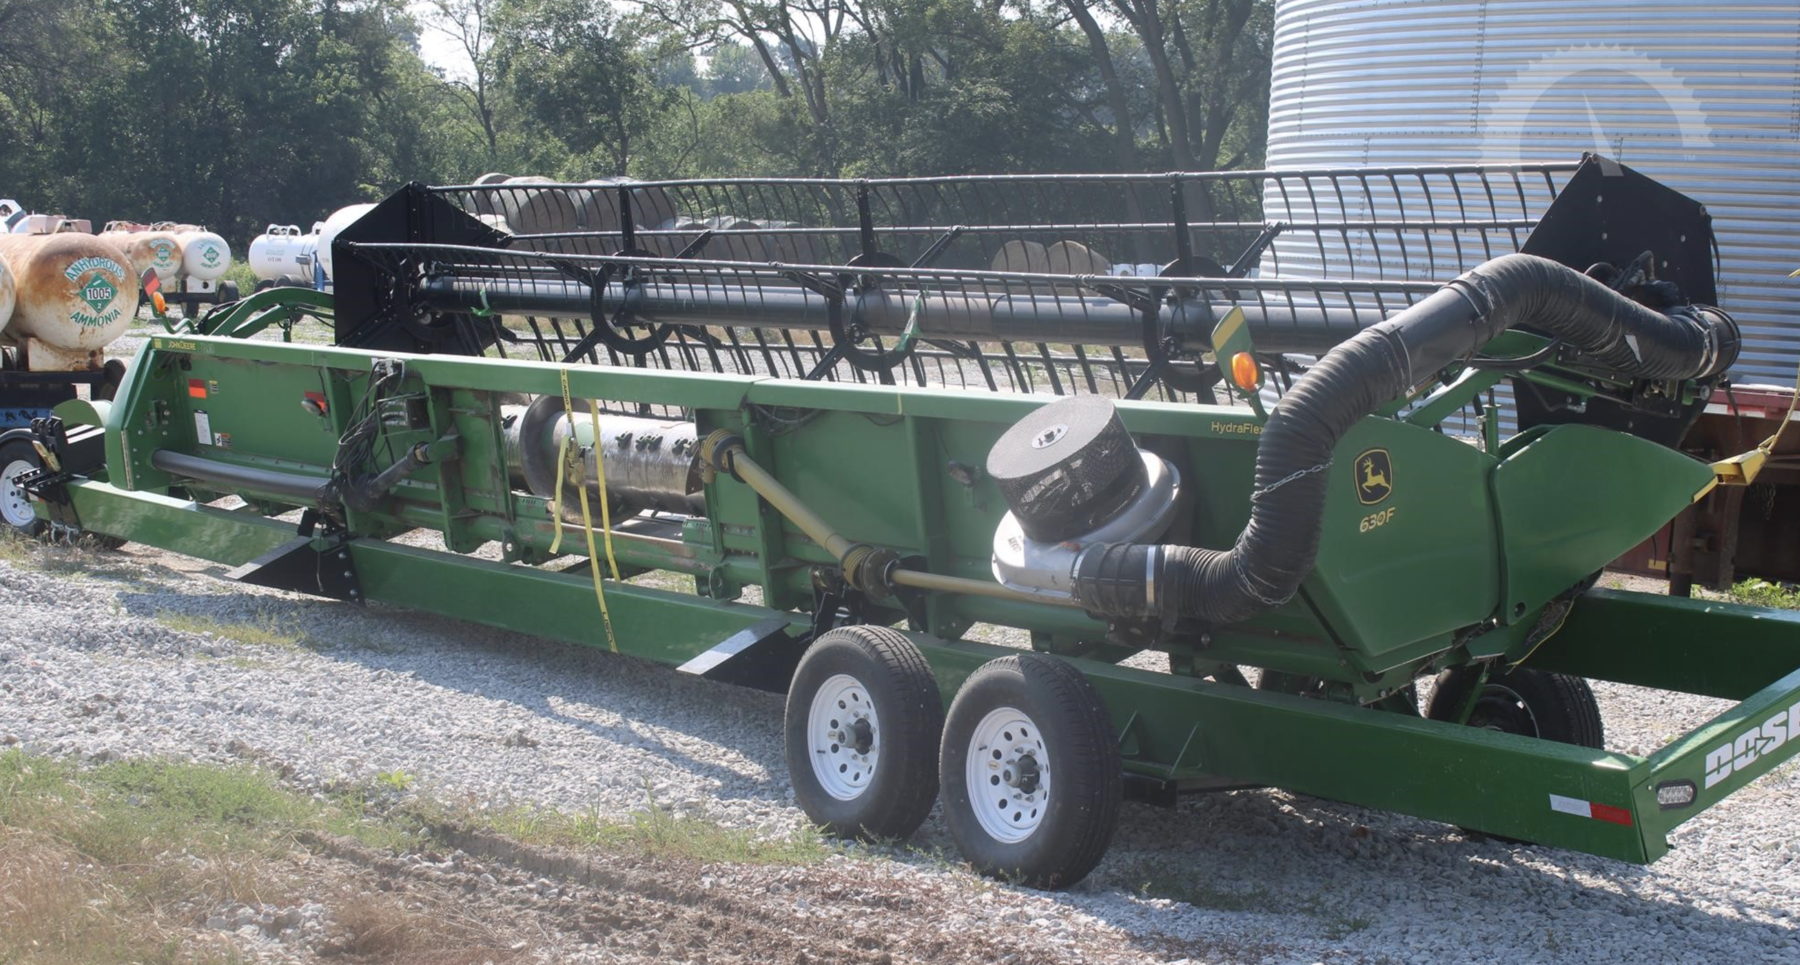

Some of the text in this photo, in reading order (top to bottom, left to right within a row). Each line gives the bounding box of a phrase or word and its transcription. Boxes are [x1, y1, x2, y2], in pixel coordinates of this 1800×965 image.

[65, 257, 125, 281] ANHYDROUS
[87, 288, 112, 299] 1005
[70, 308, 121, 327] AMMONIA
[1360, 506, 1396, 533] 630F
